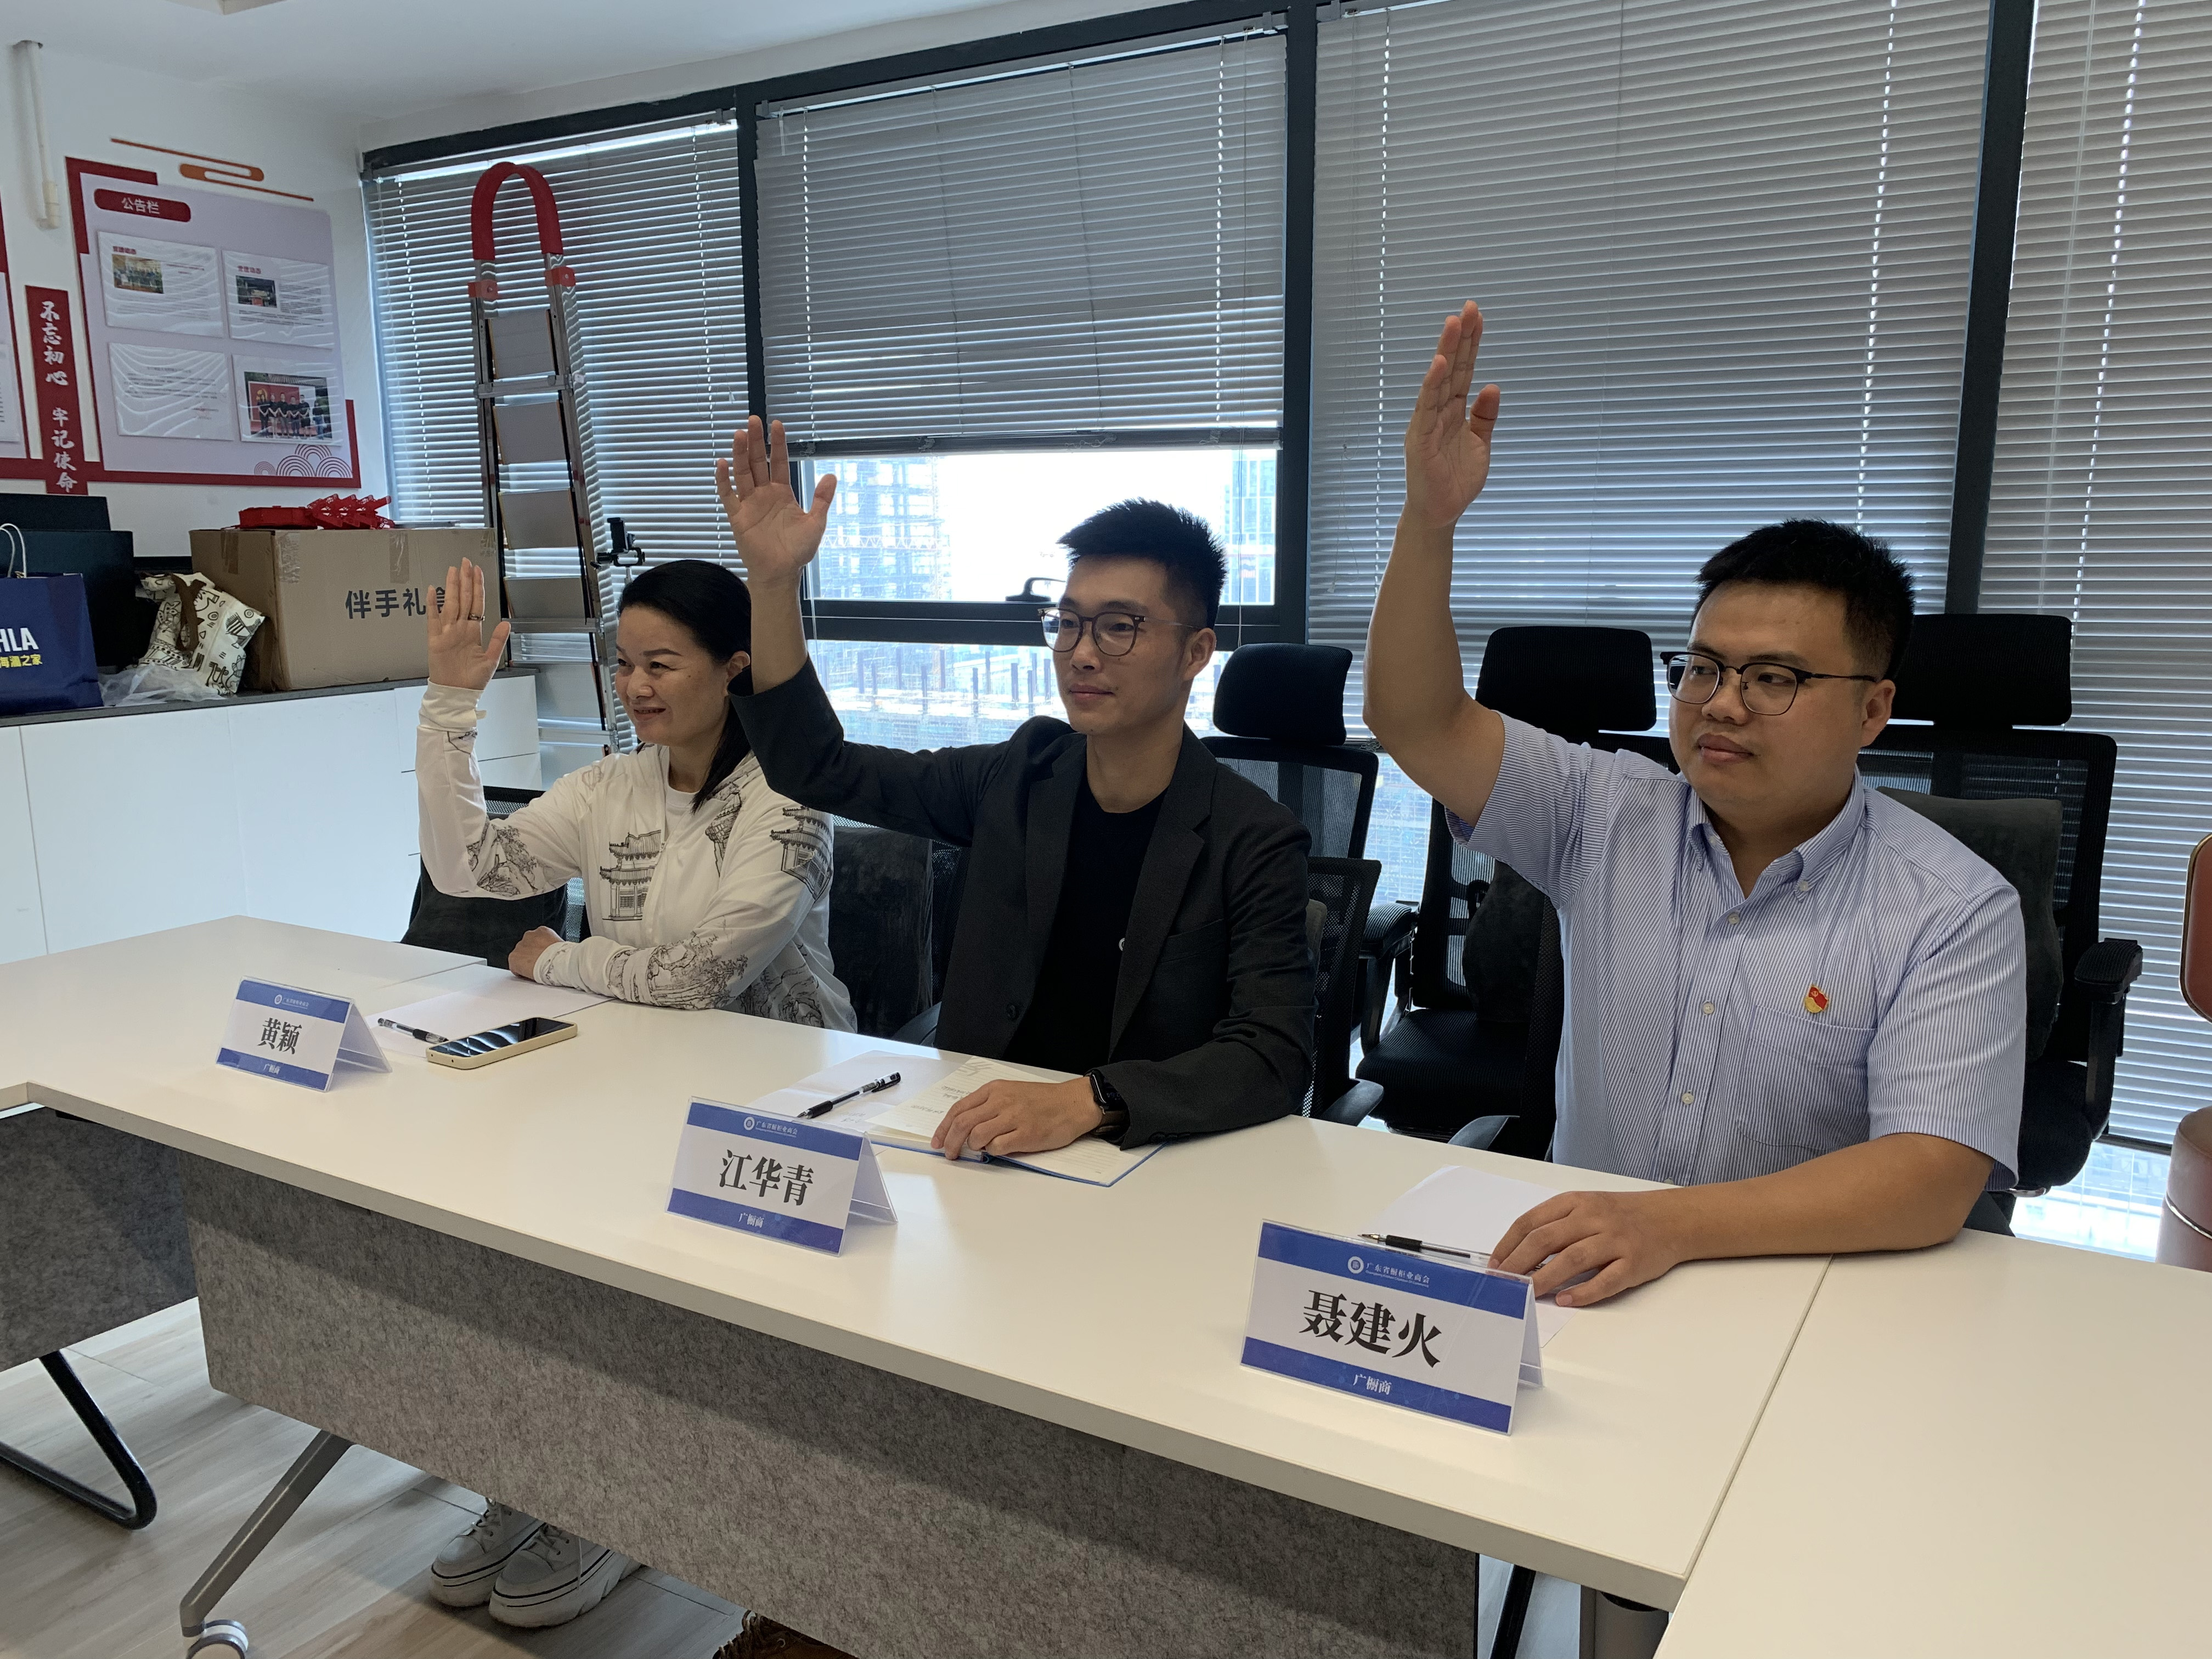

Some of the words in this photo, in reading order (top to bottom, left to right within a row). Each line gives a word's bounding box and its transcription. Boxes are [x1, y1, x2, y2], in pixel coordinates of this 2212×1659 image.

[121, 196, 160, 215] 公告栏
[40, 301, 69, 386] 不忘初心
[51, 407, 78, 493] 牢记使命
[0, 627, 39, 652] HLA
[257, 1017, 302, 1054] 黄颖
[719, 1149, 814, 1206] 江华青
[1299, 1290, 1442, 1368] 聂建火
